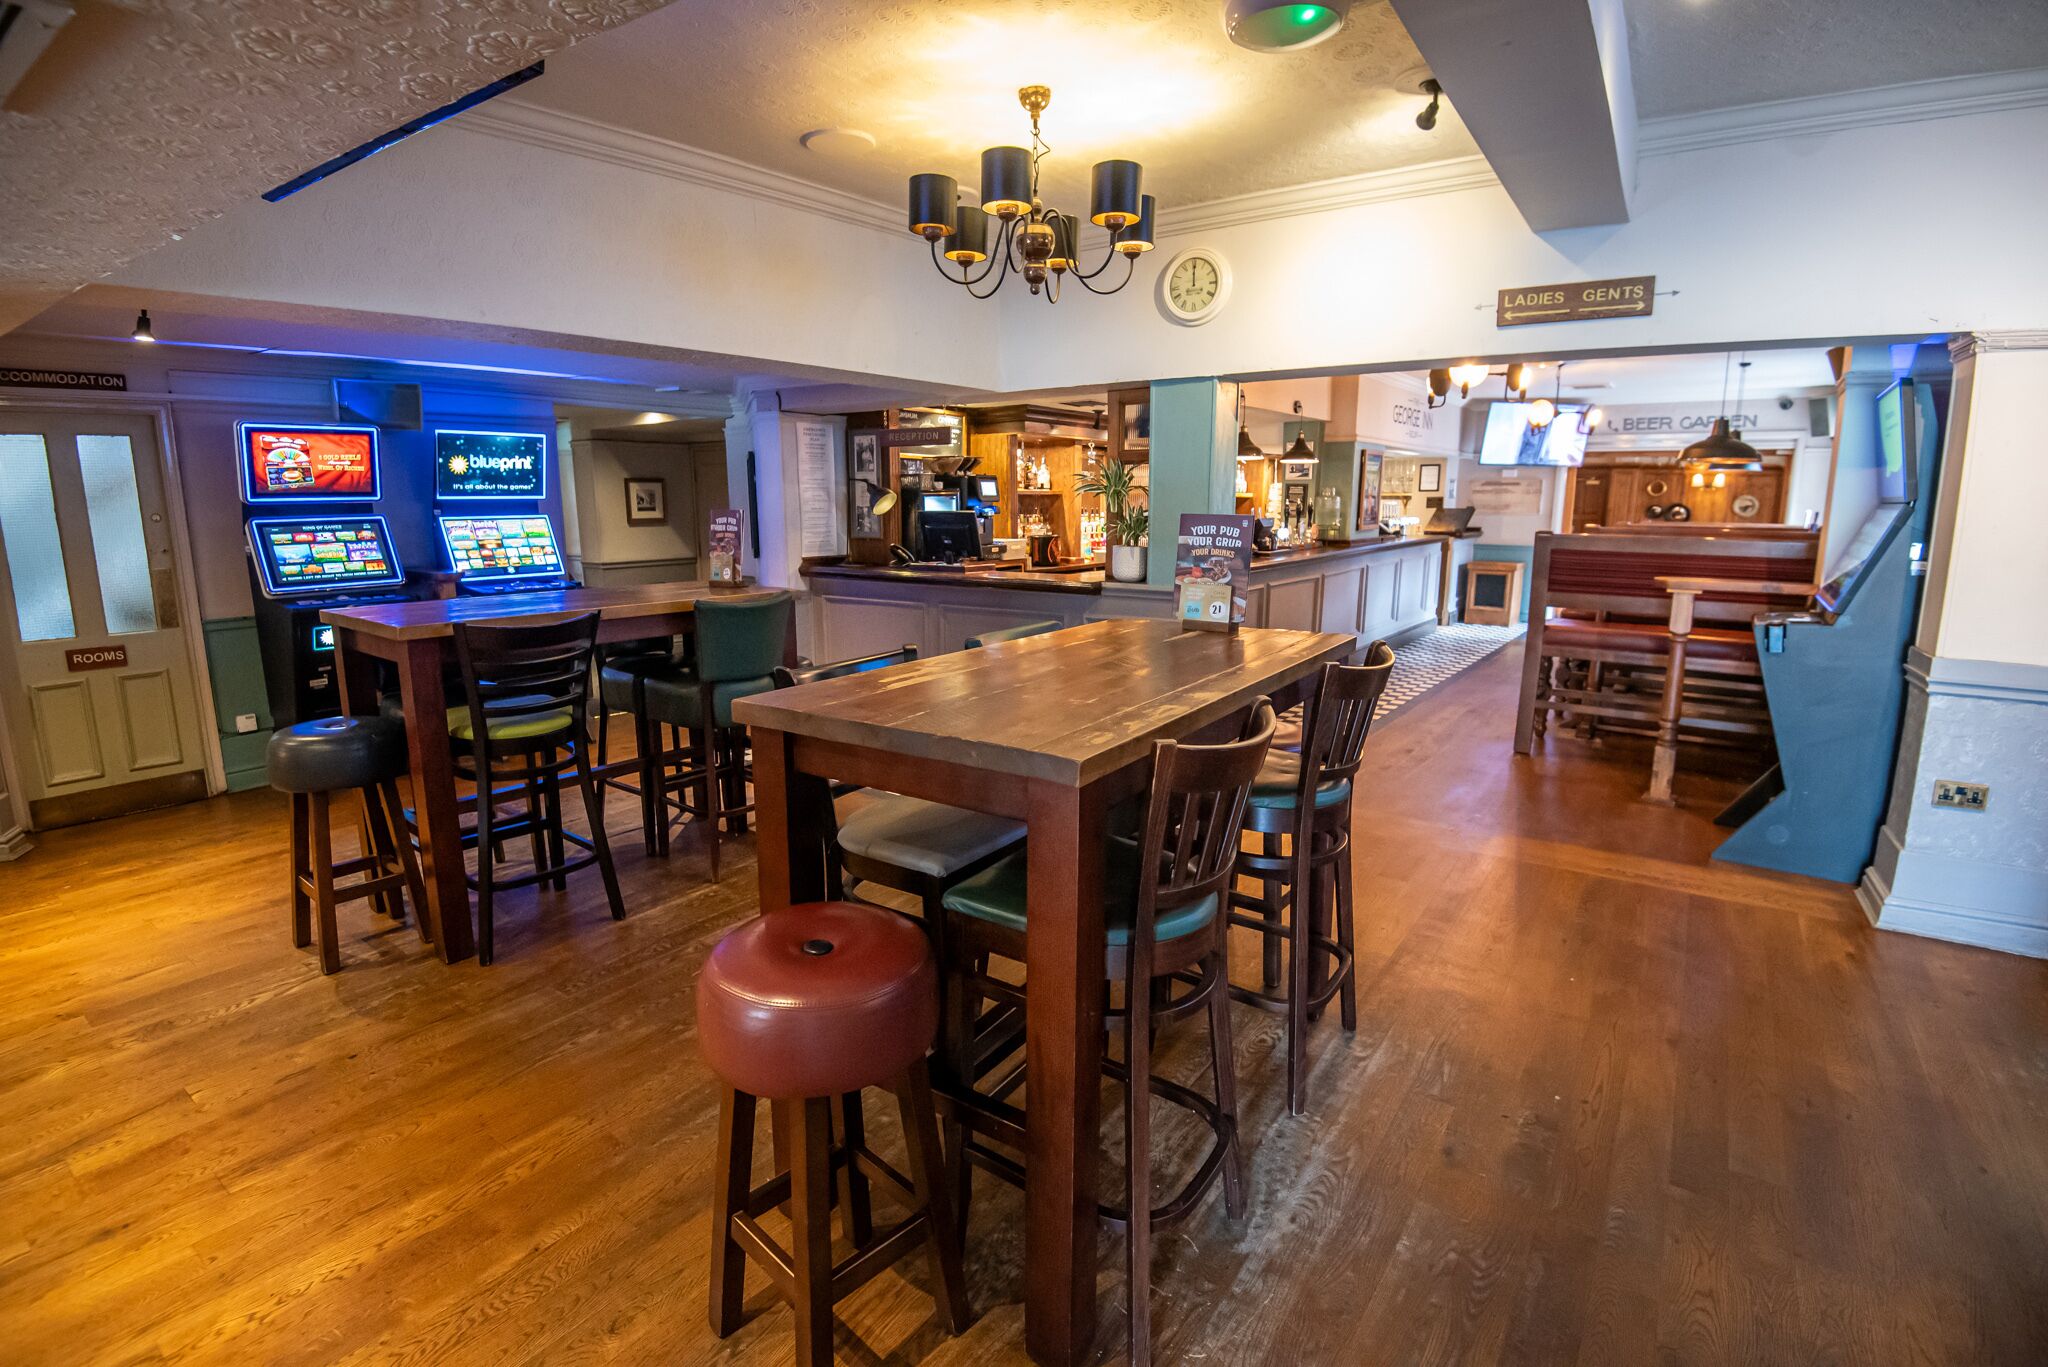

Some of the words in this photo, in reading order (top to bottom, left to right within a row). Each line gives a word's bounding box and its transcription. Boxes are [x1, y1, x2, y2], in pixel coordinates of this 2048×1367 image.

[1504, 291, 1565, 308] LADIES
[1582, 285, 1644, 302] GENTS
[0, 370, 124, 387] CCOMMODATION
[1623, 416, 1673, 431] BEER
[1679, 414, 1758, 429] GAREN
[889, 431, 939, 441] RECEPTION
[469, 453, 532, 472] blueprint
[1190, 525, 1217, 536] YOUR
[1219, 526, 1240, 538] PUB
[1188, 536, 1213, 546] YOUR
[1191, 548, 1209, 556] YOUR
[1210, 548, 1236, 558] DRINKS
[1212, 604, 1222, 614] 21
[72, 650, 125, 664] ROOMS
